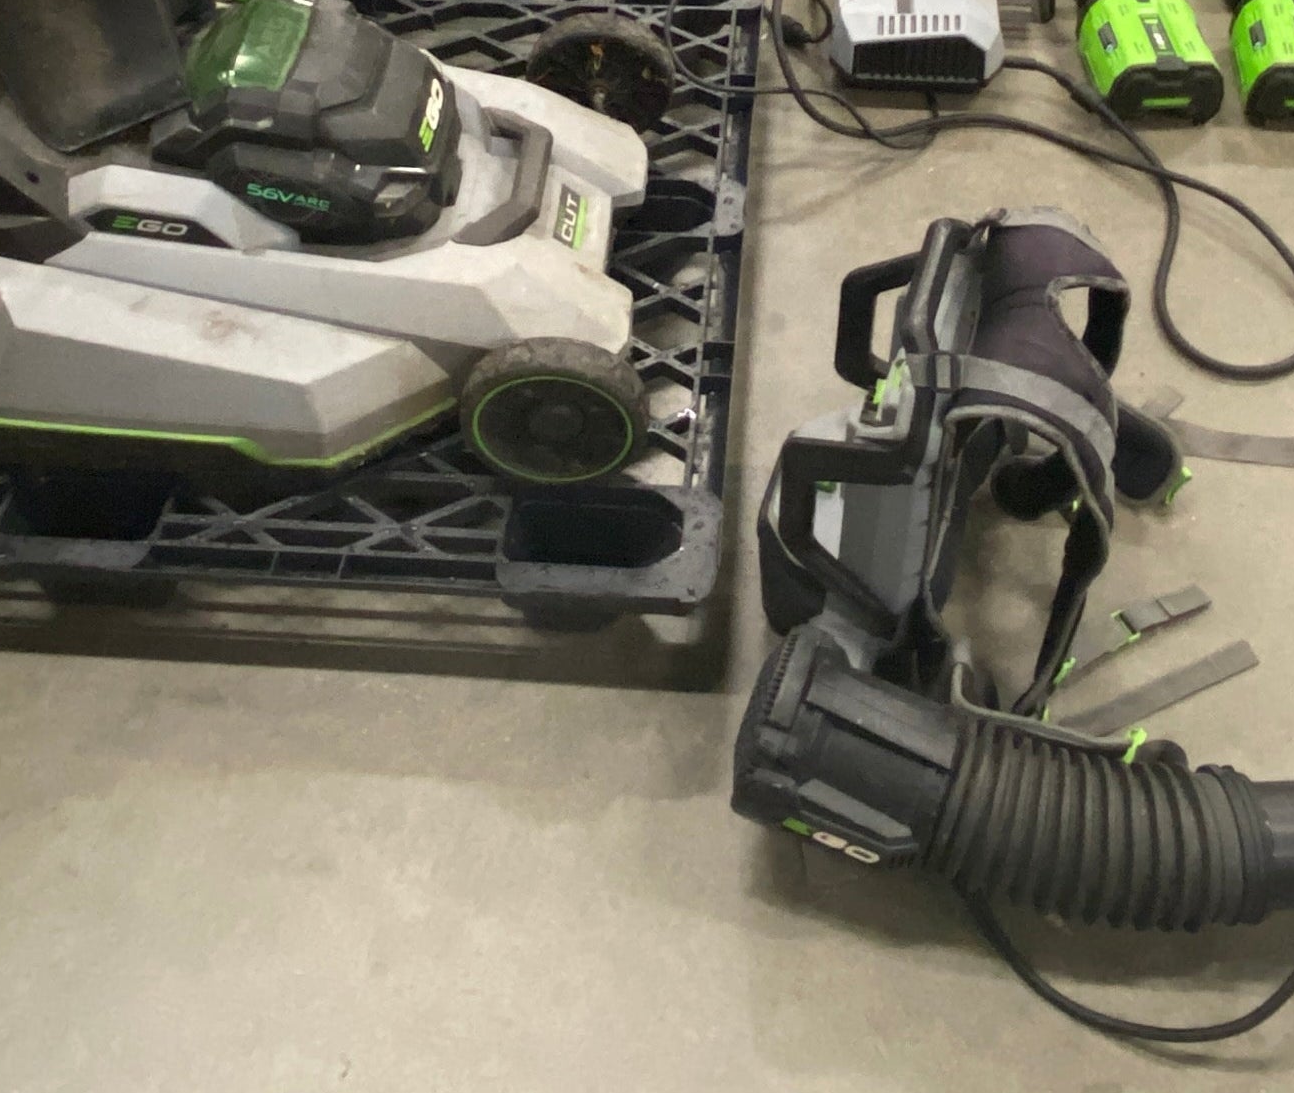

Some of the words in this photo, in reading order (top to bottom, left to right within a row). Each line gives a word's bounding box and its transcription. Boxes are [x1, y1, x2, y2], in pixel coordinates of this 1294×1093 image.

[418, 78, 444, 153] EGO
[112, 214, 189, 237] EGO
[561, 193, 578, 242] CUT
